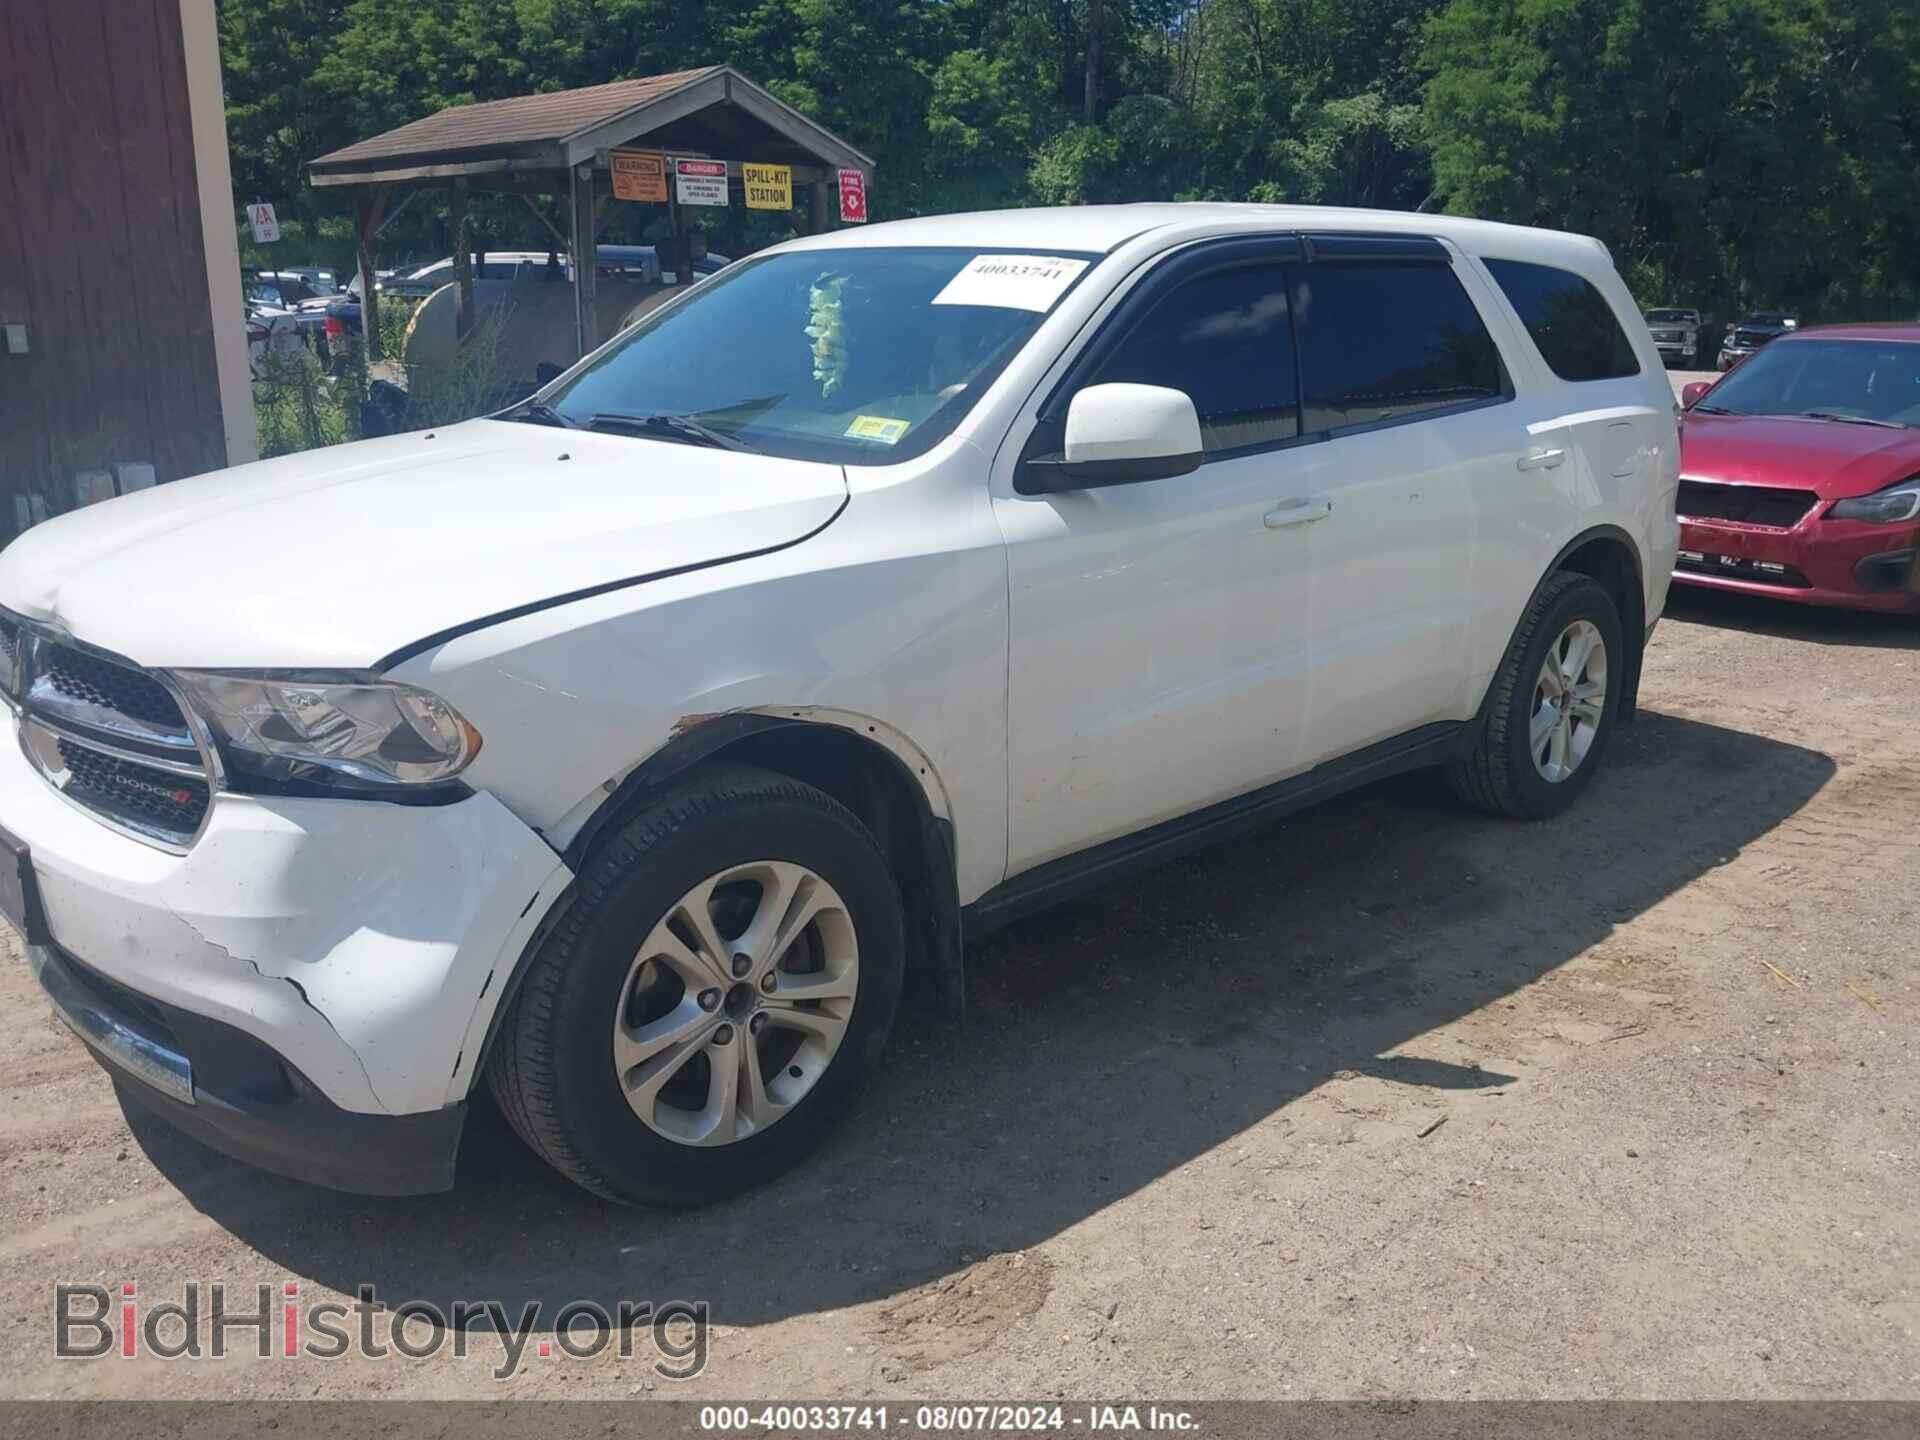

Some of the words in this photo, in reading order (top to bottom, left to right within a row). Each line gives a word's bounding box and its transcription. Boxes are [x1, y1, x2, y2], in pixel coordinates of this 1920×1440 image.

[746, 168, 788, 184] SPILL-KIT
[750, 187, 786, 202] STATION
[974, 263, 1062, 279] 40033741
[115, 774, 177, 800] DODGE
